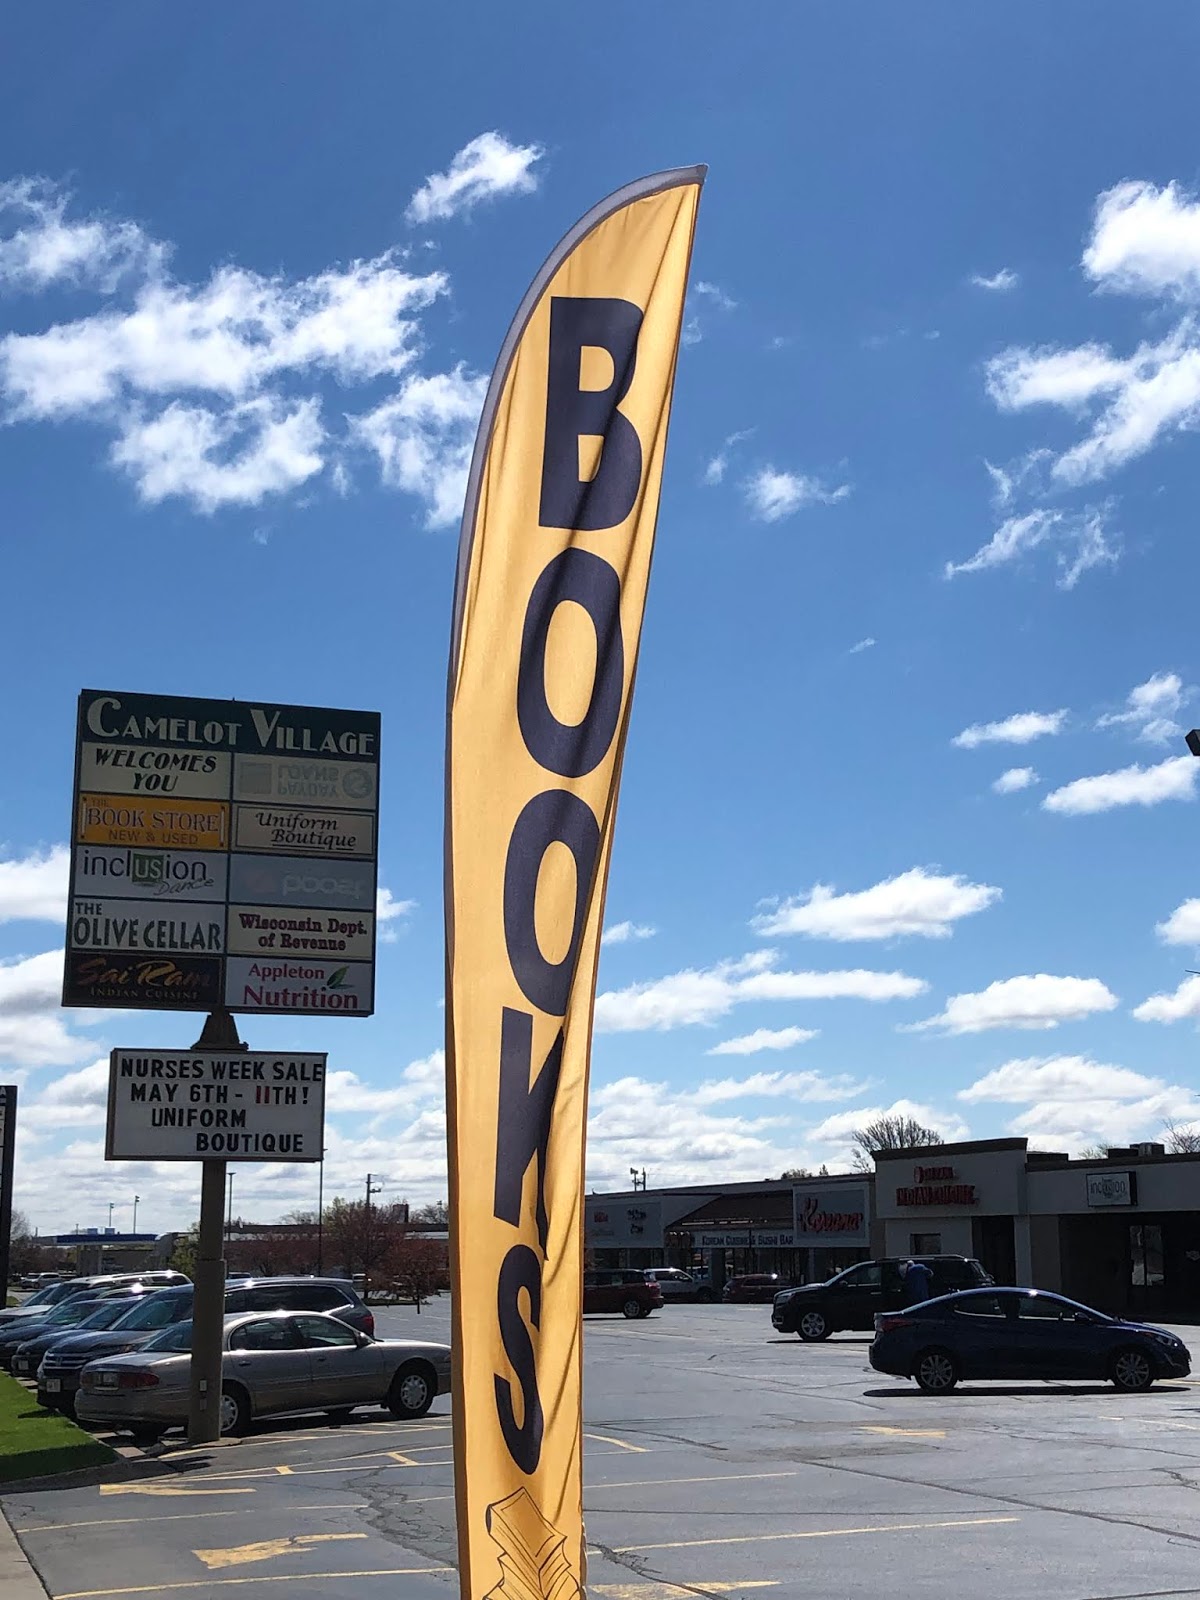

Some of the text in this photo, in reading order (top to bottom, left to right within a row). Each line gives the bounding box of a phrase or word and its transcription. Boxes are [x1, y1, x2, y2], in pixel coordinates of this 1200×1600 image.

[87, 697, 375, 756] CAMELOT VILLAGE
[95, 748, 217, 773] WELCOMES
[132, 774, 178, 792] YOU
[88, 808, 219, 833] BOOK STORE
[256, 812, 338, 832] Uniform
[108, 829, 198, 845] NEW & USED
[271, 828, 356, 850] Boutique
[83, 850, 207, 882] inclusion
[154, 877, 215, 896] Dance
[494, 296, 644, 1474] BOOKS
[75, 902, 103, 915] THE
[74, 917, 222, 951] OLIVE CELLAR
[238, 913, 368, 937] Wisconsin Dept.
[258, 933, 347, 951] of Revenue
[248, 963, 325, 986] Appleton
[243, 985, 359, 1010] Nutrition
[121, 1058, 324, 1082] NURSES WEEK SALE
[130, 1083, 179, 1102] MAY
[190, 1084, 229, 1103] 6TH
[151, 1107, 247, 1128] UNIFORM
[196, 1133, 304, 1153] BOUTIQUE
[779, 1234, 794, 1245] BAR
